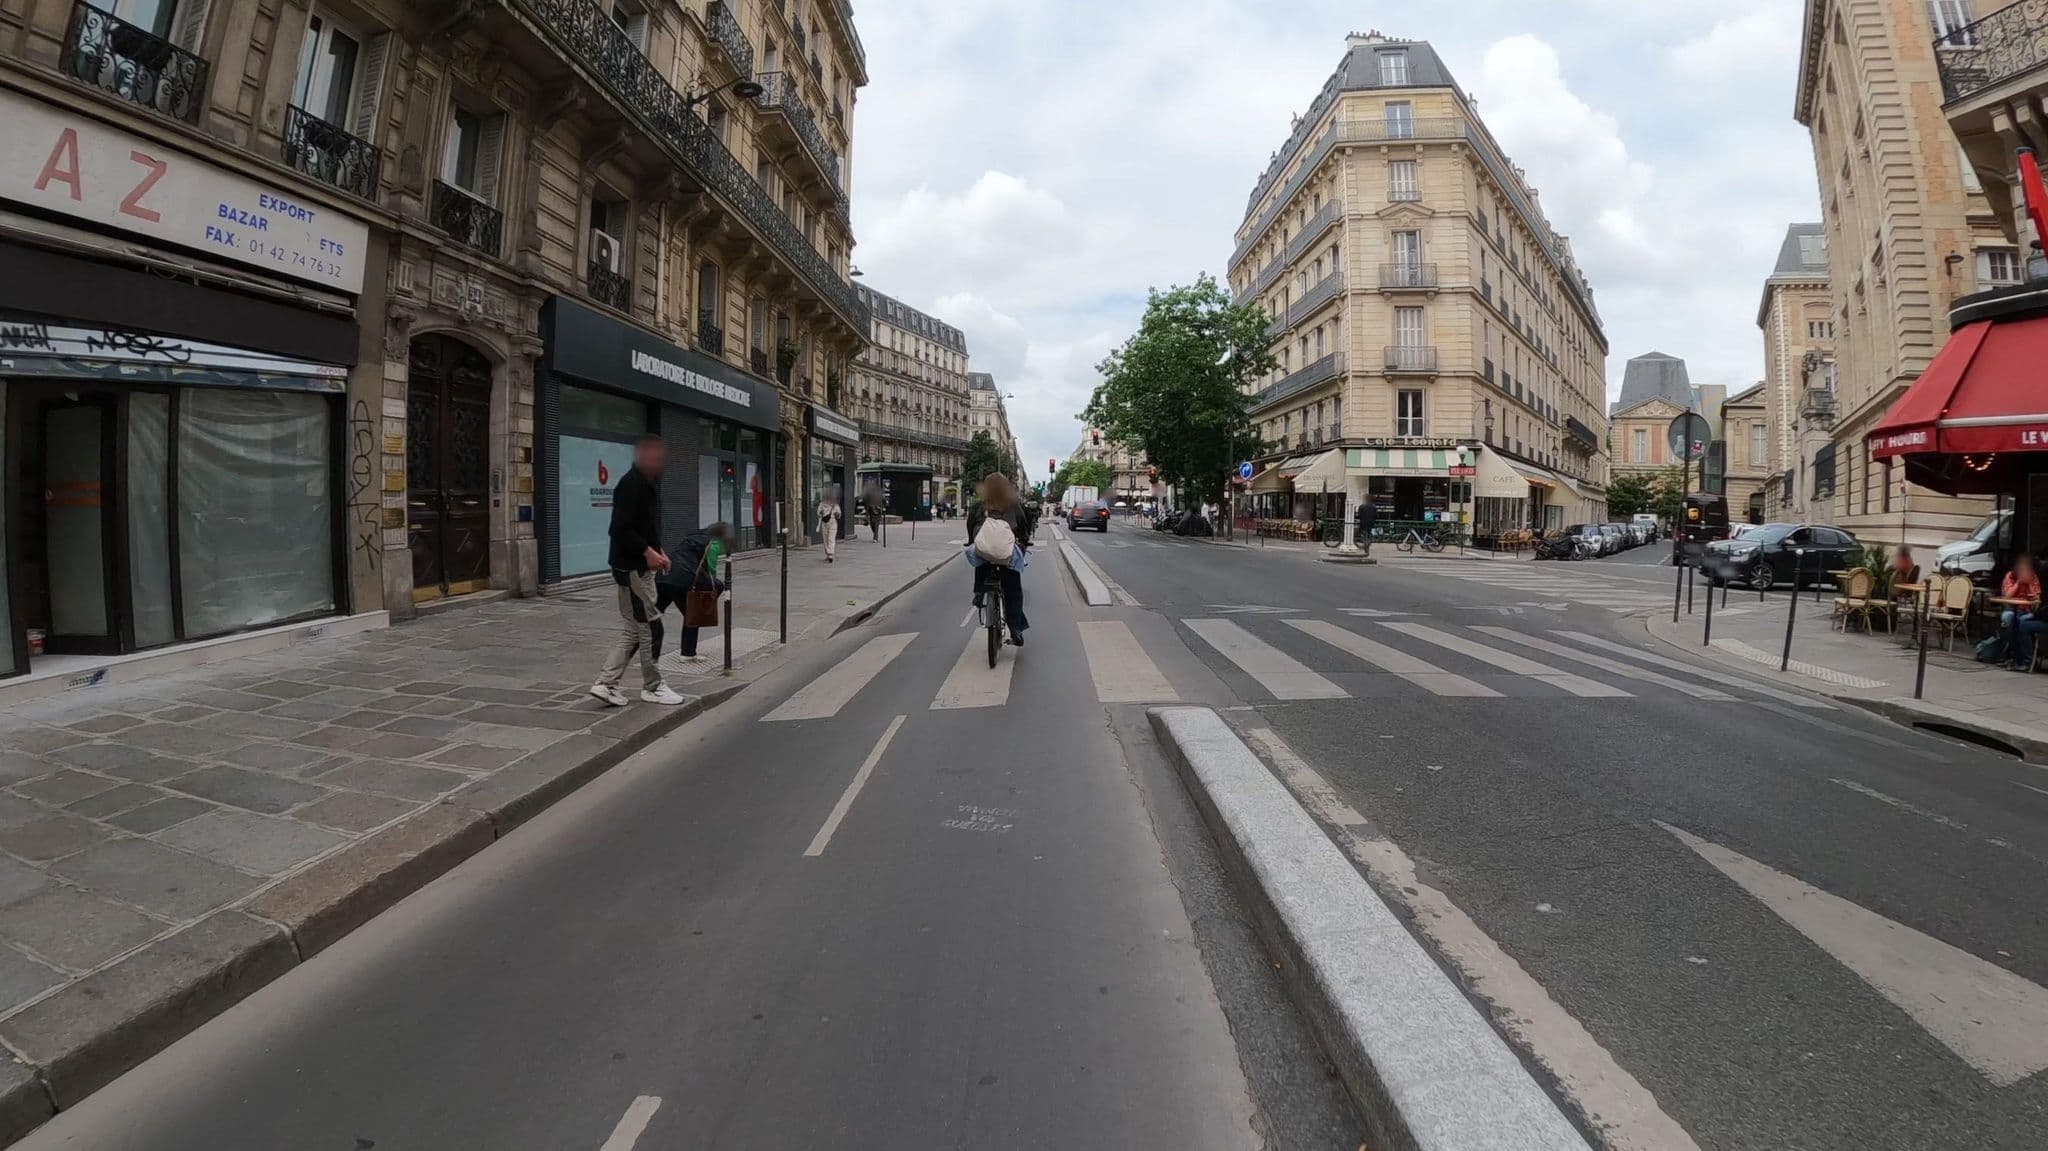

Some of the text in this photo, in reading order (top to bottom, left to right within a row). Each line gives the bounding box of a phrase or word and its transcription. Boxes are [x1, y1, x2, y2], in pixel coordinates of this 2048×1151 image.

[33, 127, 167, 223] A Z
[258, 193, 315, 224] EXPORT
[217, 203, 344, 257] BAZAR ETS
[250, 239, 264, 255] 01
[270, 245, 285, 261] 42
[292, 251, 306, 267] 74
[310, 257, 324, 273] 76
[327, 264, 341, 278] 32
[631, 349, 685, 386] LABORATOIRE
[685, 369, 696, 389] DE
[2022, 431, 2038, 444] LE
